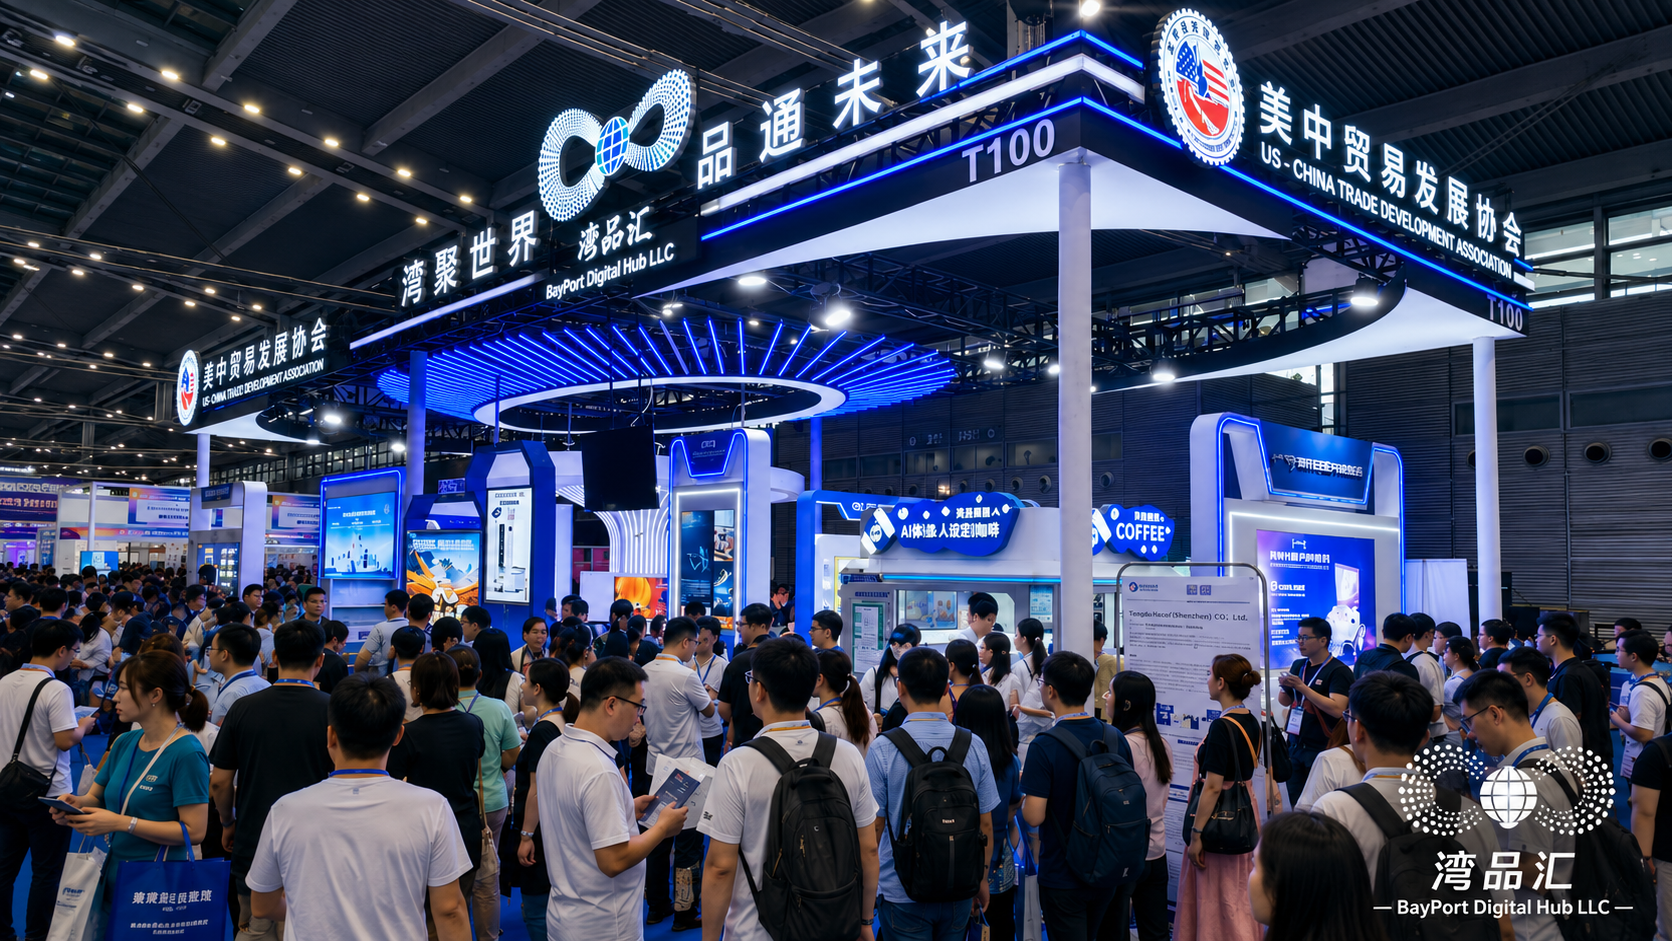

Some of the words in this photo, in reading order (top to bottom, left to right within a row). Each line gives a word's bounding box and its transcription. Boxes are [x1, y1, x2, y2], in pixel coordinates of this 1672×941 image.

[697, 20, 971, 190] 品通未来
[961, 118, 1056, 183] T100
[1259, 80, 1522, 258] 美中贸易发展协会
[577, 206, 653, 261] 湾品汇
[1261, 141, 1281, 169] US
[1293, 158, 1336, 196] CHINA
[1337, 178, 1379, 215] TRADE
[1380, 199, 1455, 251] DEVELOPMENT
[1456, 238, 1512, 279] ASSOCIATION
[400, 210, 538, 308] 湾聚世界
[546, 274, 585, 300] BayPort
[586, 260, 621, 287] Digital
[623, 253, 647, 275] Hub
[649, 242, 675, 267] LLC
[1487, 294, 1523, 332] T100
[203, 317, 327, 391] 美中贸易发展协会
[1116, 522, 1165, 542] COFFEE
